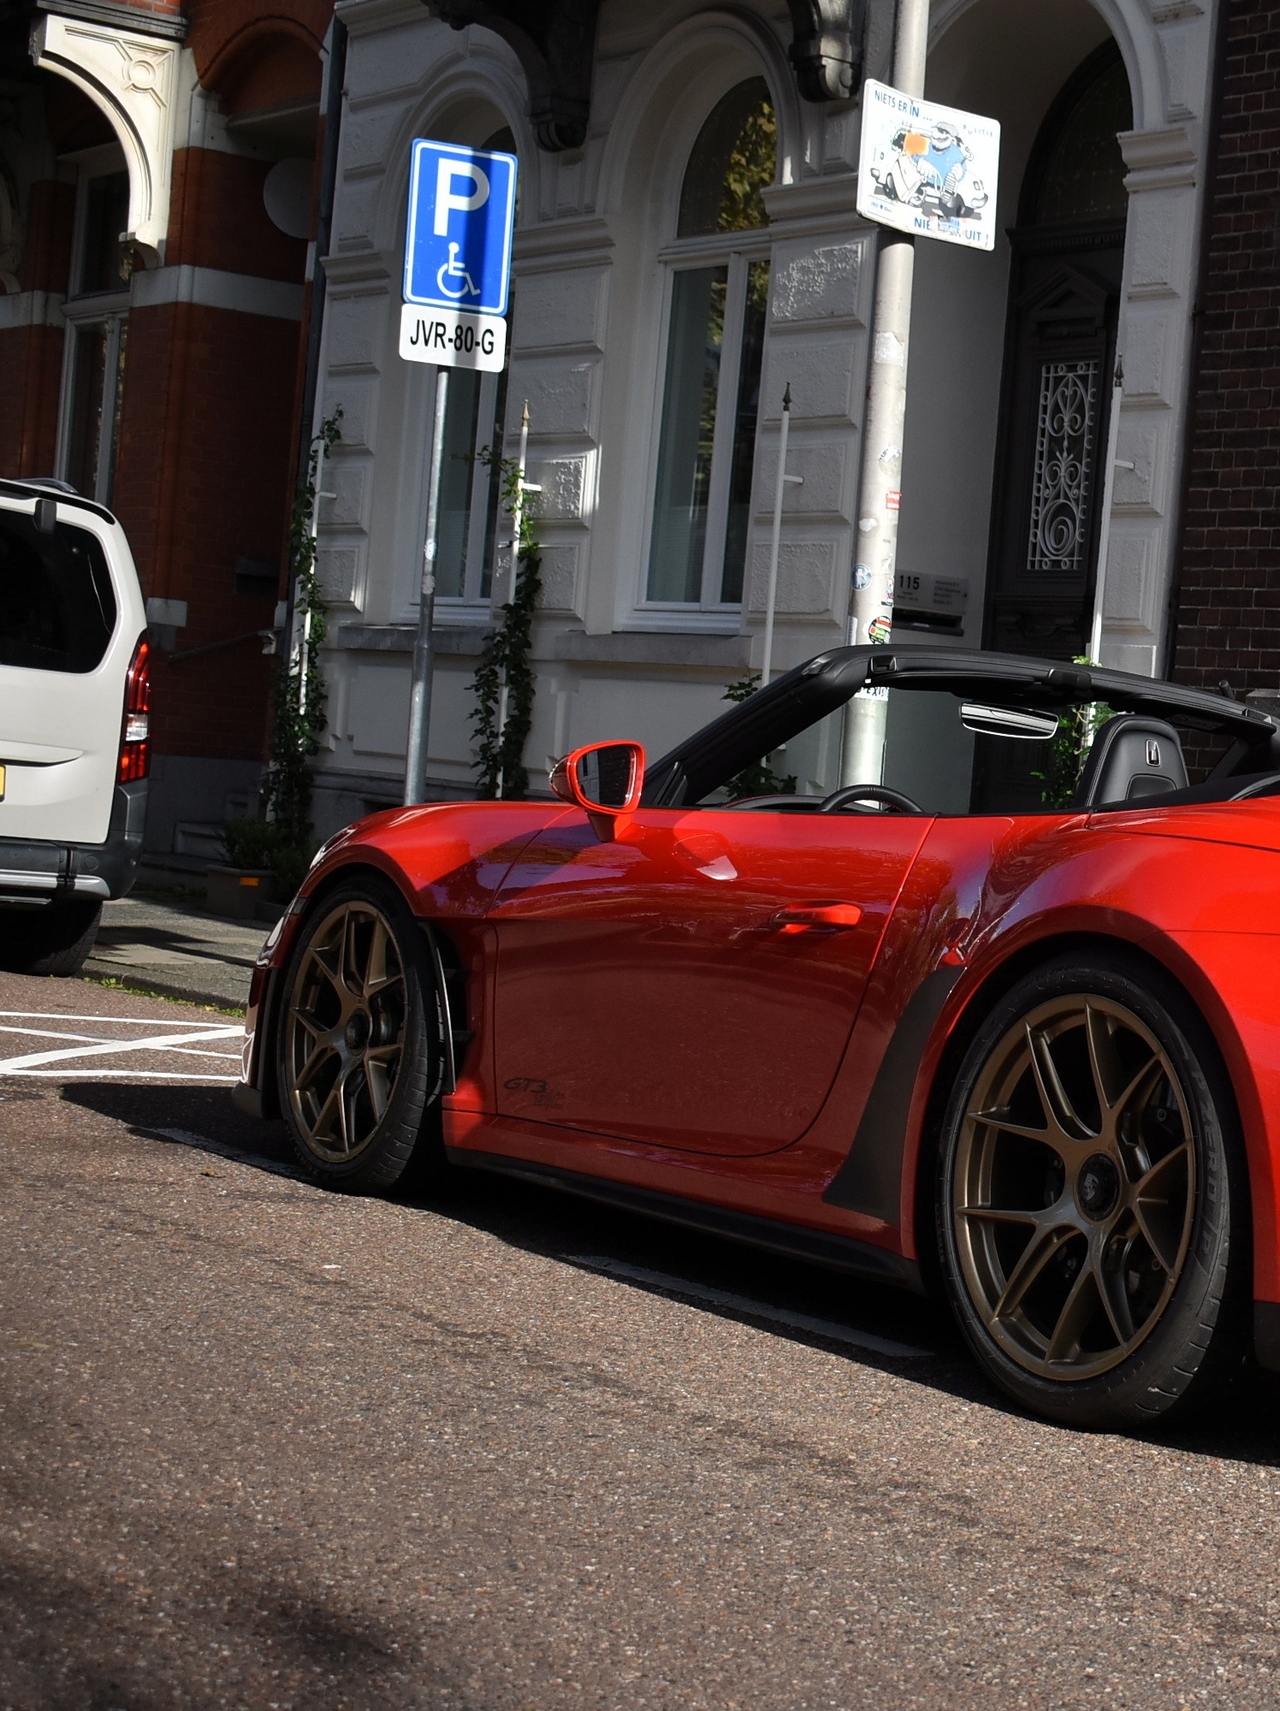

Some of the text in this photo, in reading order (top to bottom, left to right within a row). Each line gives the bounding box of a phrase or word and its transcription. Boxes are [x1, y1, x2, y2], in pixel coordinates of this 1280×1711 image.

[875, 90, 896, 108] NIETS
[898, 100, 908, 113] ER
[909, 105, 920, 118] IN
[434, 157, 490, 237] P
[965, 230, 982, 242] UIT
[409, 319, 495, 355] JVR-80-G
[900, 575, 920, 590] 115
[503, 1077, 548, 1093] GT3
